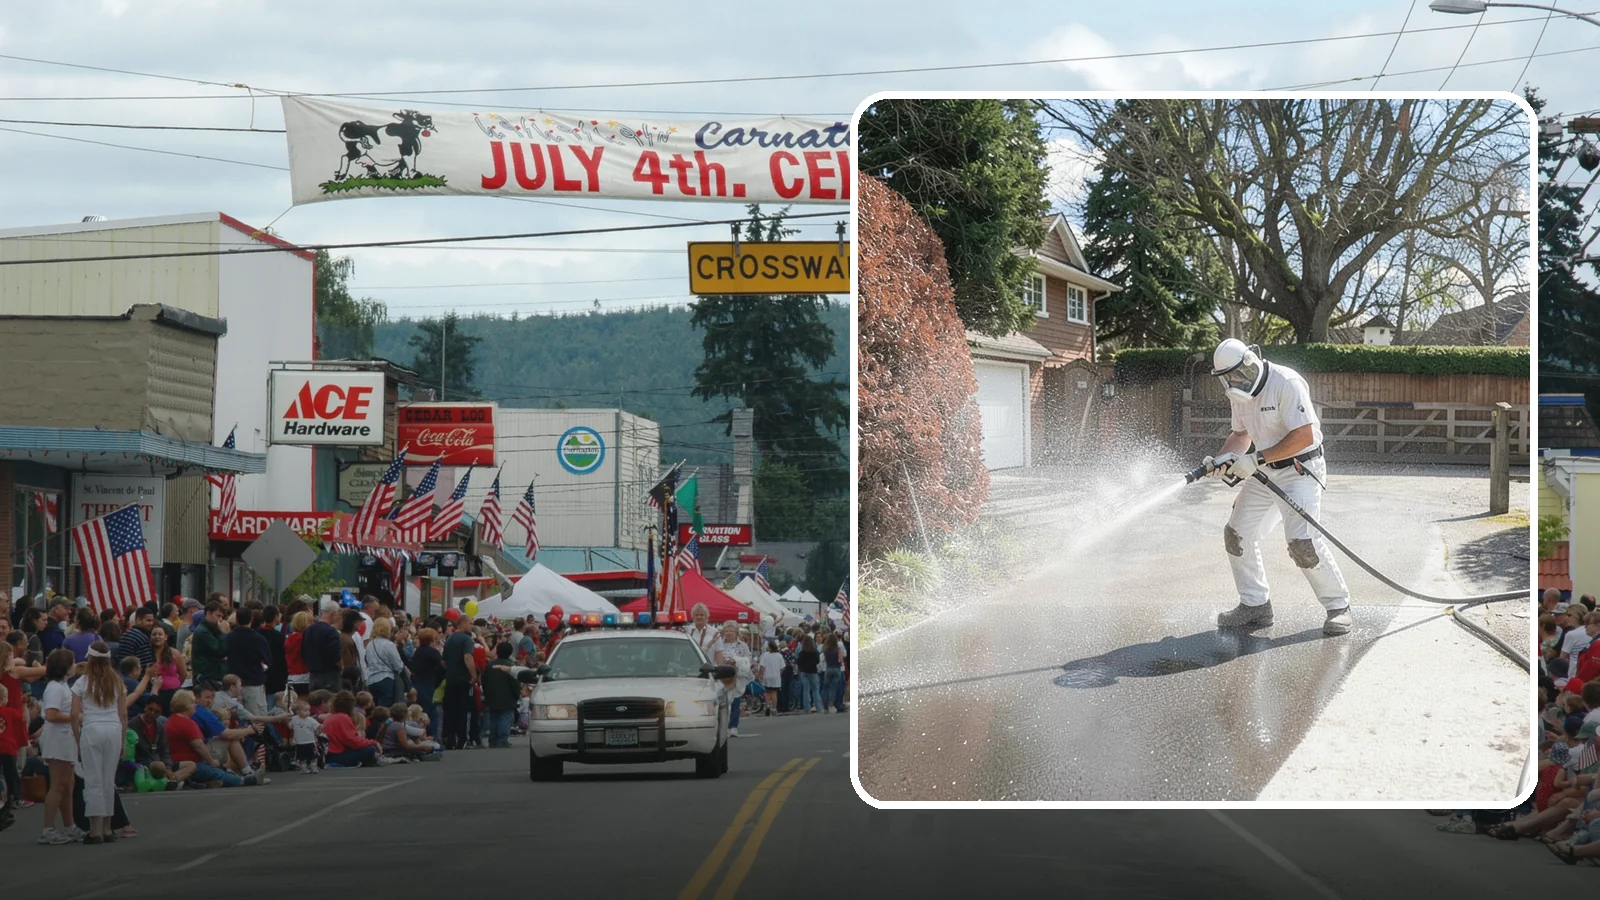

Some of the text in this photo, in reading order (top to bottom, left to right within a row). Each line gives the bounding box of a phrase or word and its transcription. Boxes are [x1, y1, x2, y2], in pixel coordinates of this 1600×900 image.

[695, 121, 850, 150] Carnat
[481, 140, 605, 192] JULY
[632, 150, 746, 198] 4th.
[697, 254, 850, 280] CROSSWA
[282, 379, 374, 420] ACE
[405, 409, 453, 422] CEDAR
[283, 421, 371, 437] Hardware
[416, 428, 477, 447] Coca-Cola
[353, 467, 385, 480] Simpl
[95, 484, 124, 495] Vincent
[126, 485, 136, 495] de
[137, 485, 155, 496] Paul
[212, 516, 331, 535] HARDARE
[688, 526, 742, 535] CRNATION
[699, 535, 730, 543] GLASS
